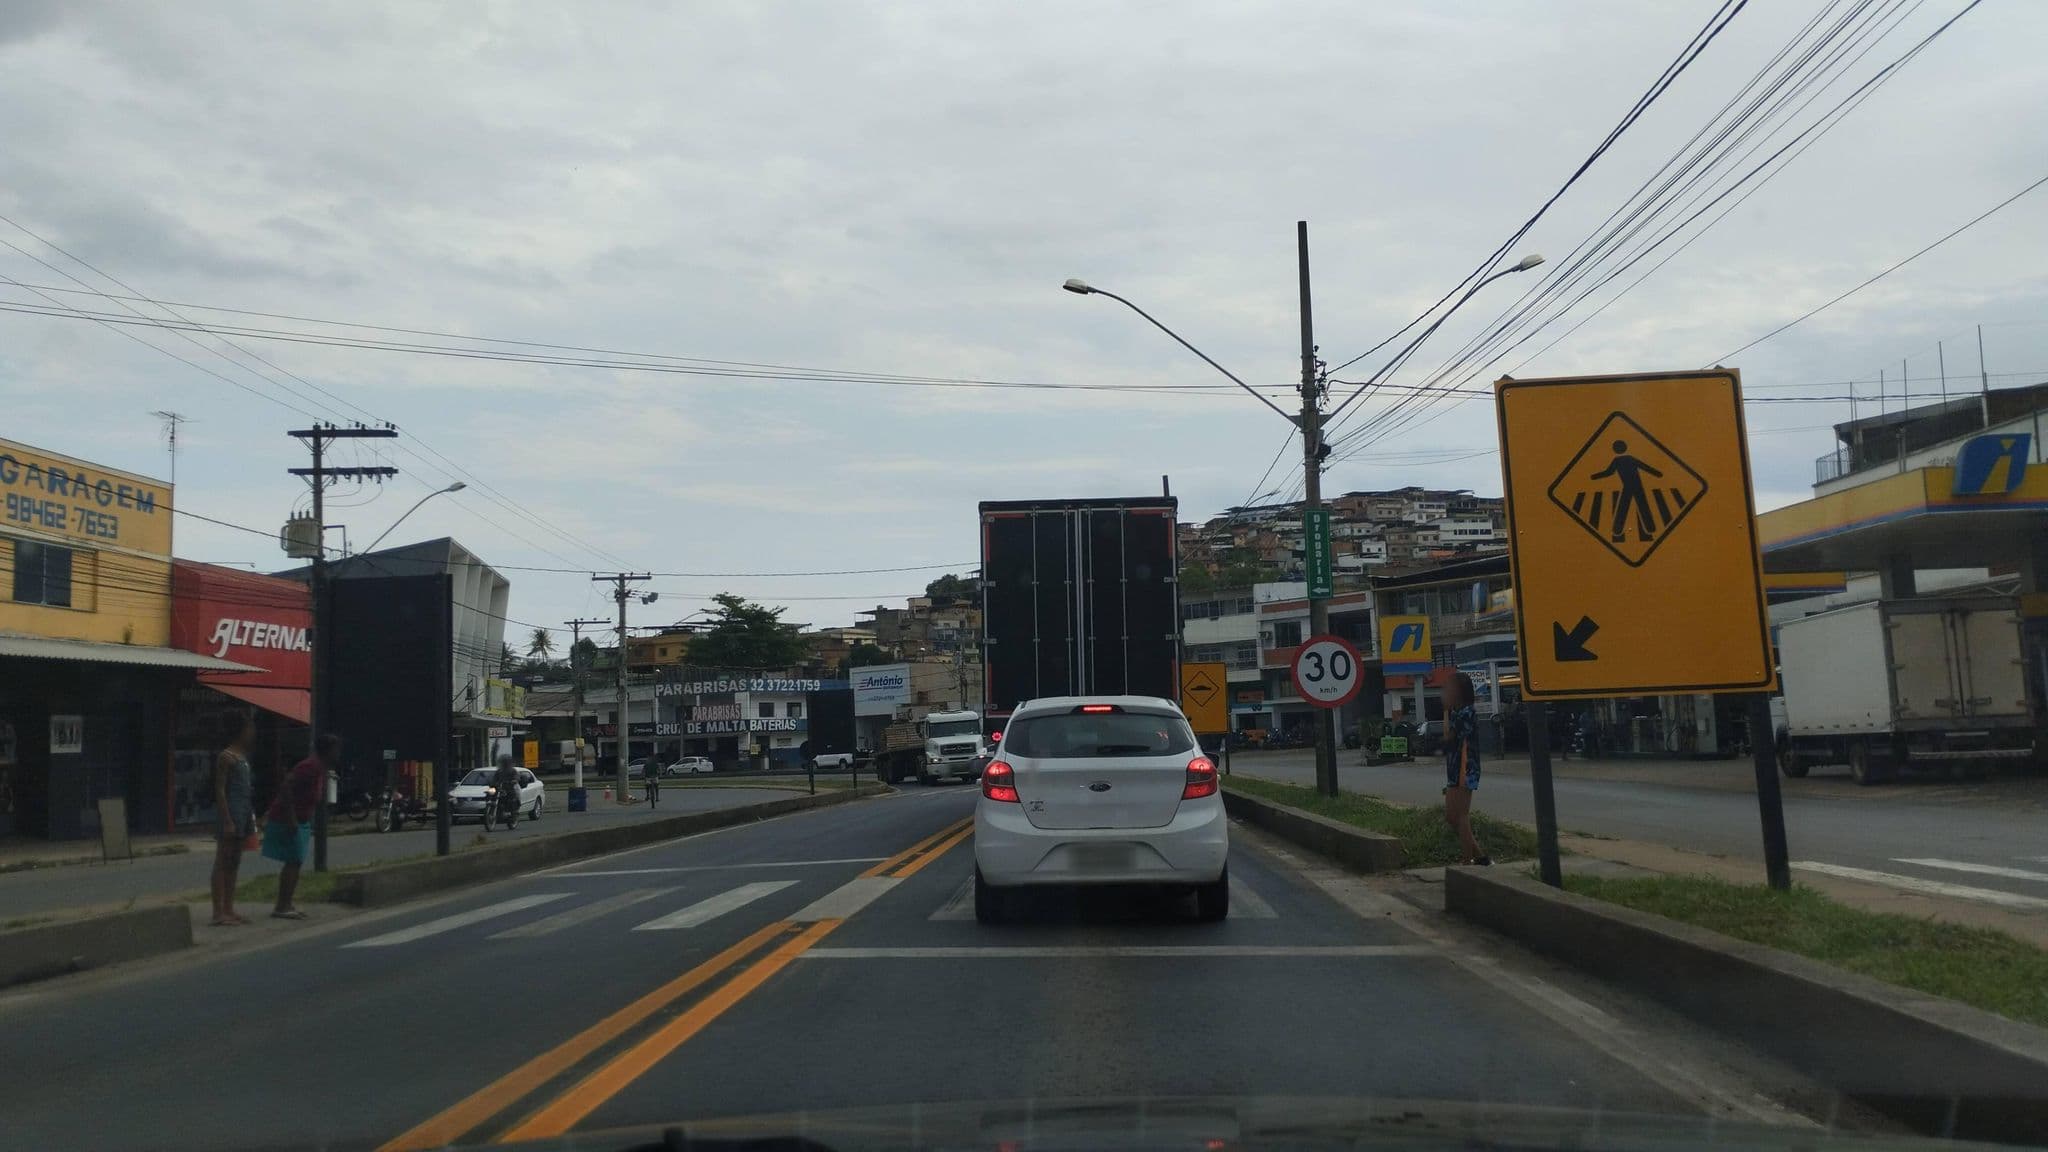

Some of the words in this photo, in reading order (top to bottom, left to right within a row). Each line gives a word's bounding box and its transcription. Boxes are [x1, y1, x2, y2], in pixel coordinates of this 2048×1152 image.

[0, 453, 155, 514] GARAGEM
[208, 618, 312, 658] ALTERNA
[1305, 651, 1351, 682] 30
[655, 679, 747, 697] PARABRISAS
[750, 678, 764, 691] 32
[867, 675, 903, 687] Antônio
[1320, 687, 1338, 695] km/h
[692, 704, 742, 722] PARABRISAS
[687, 722, 702, 734] DE
[706, 720, 747, 733] MALTA
[750, 719, 796, 732] BATERIAS
